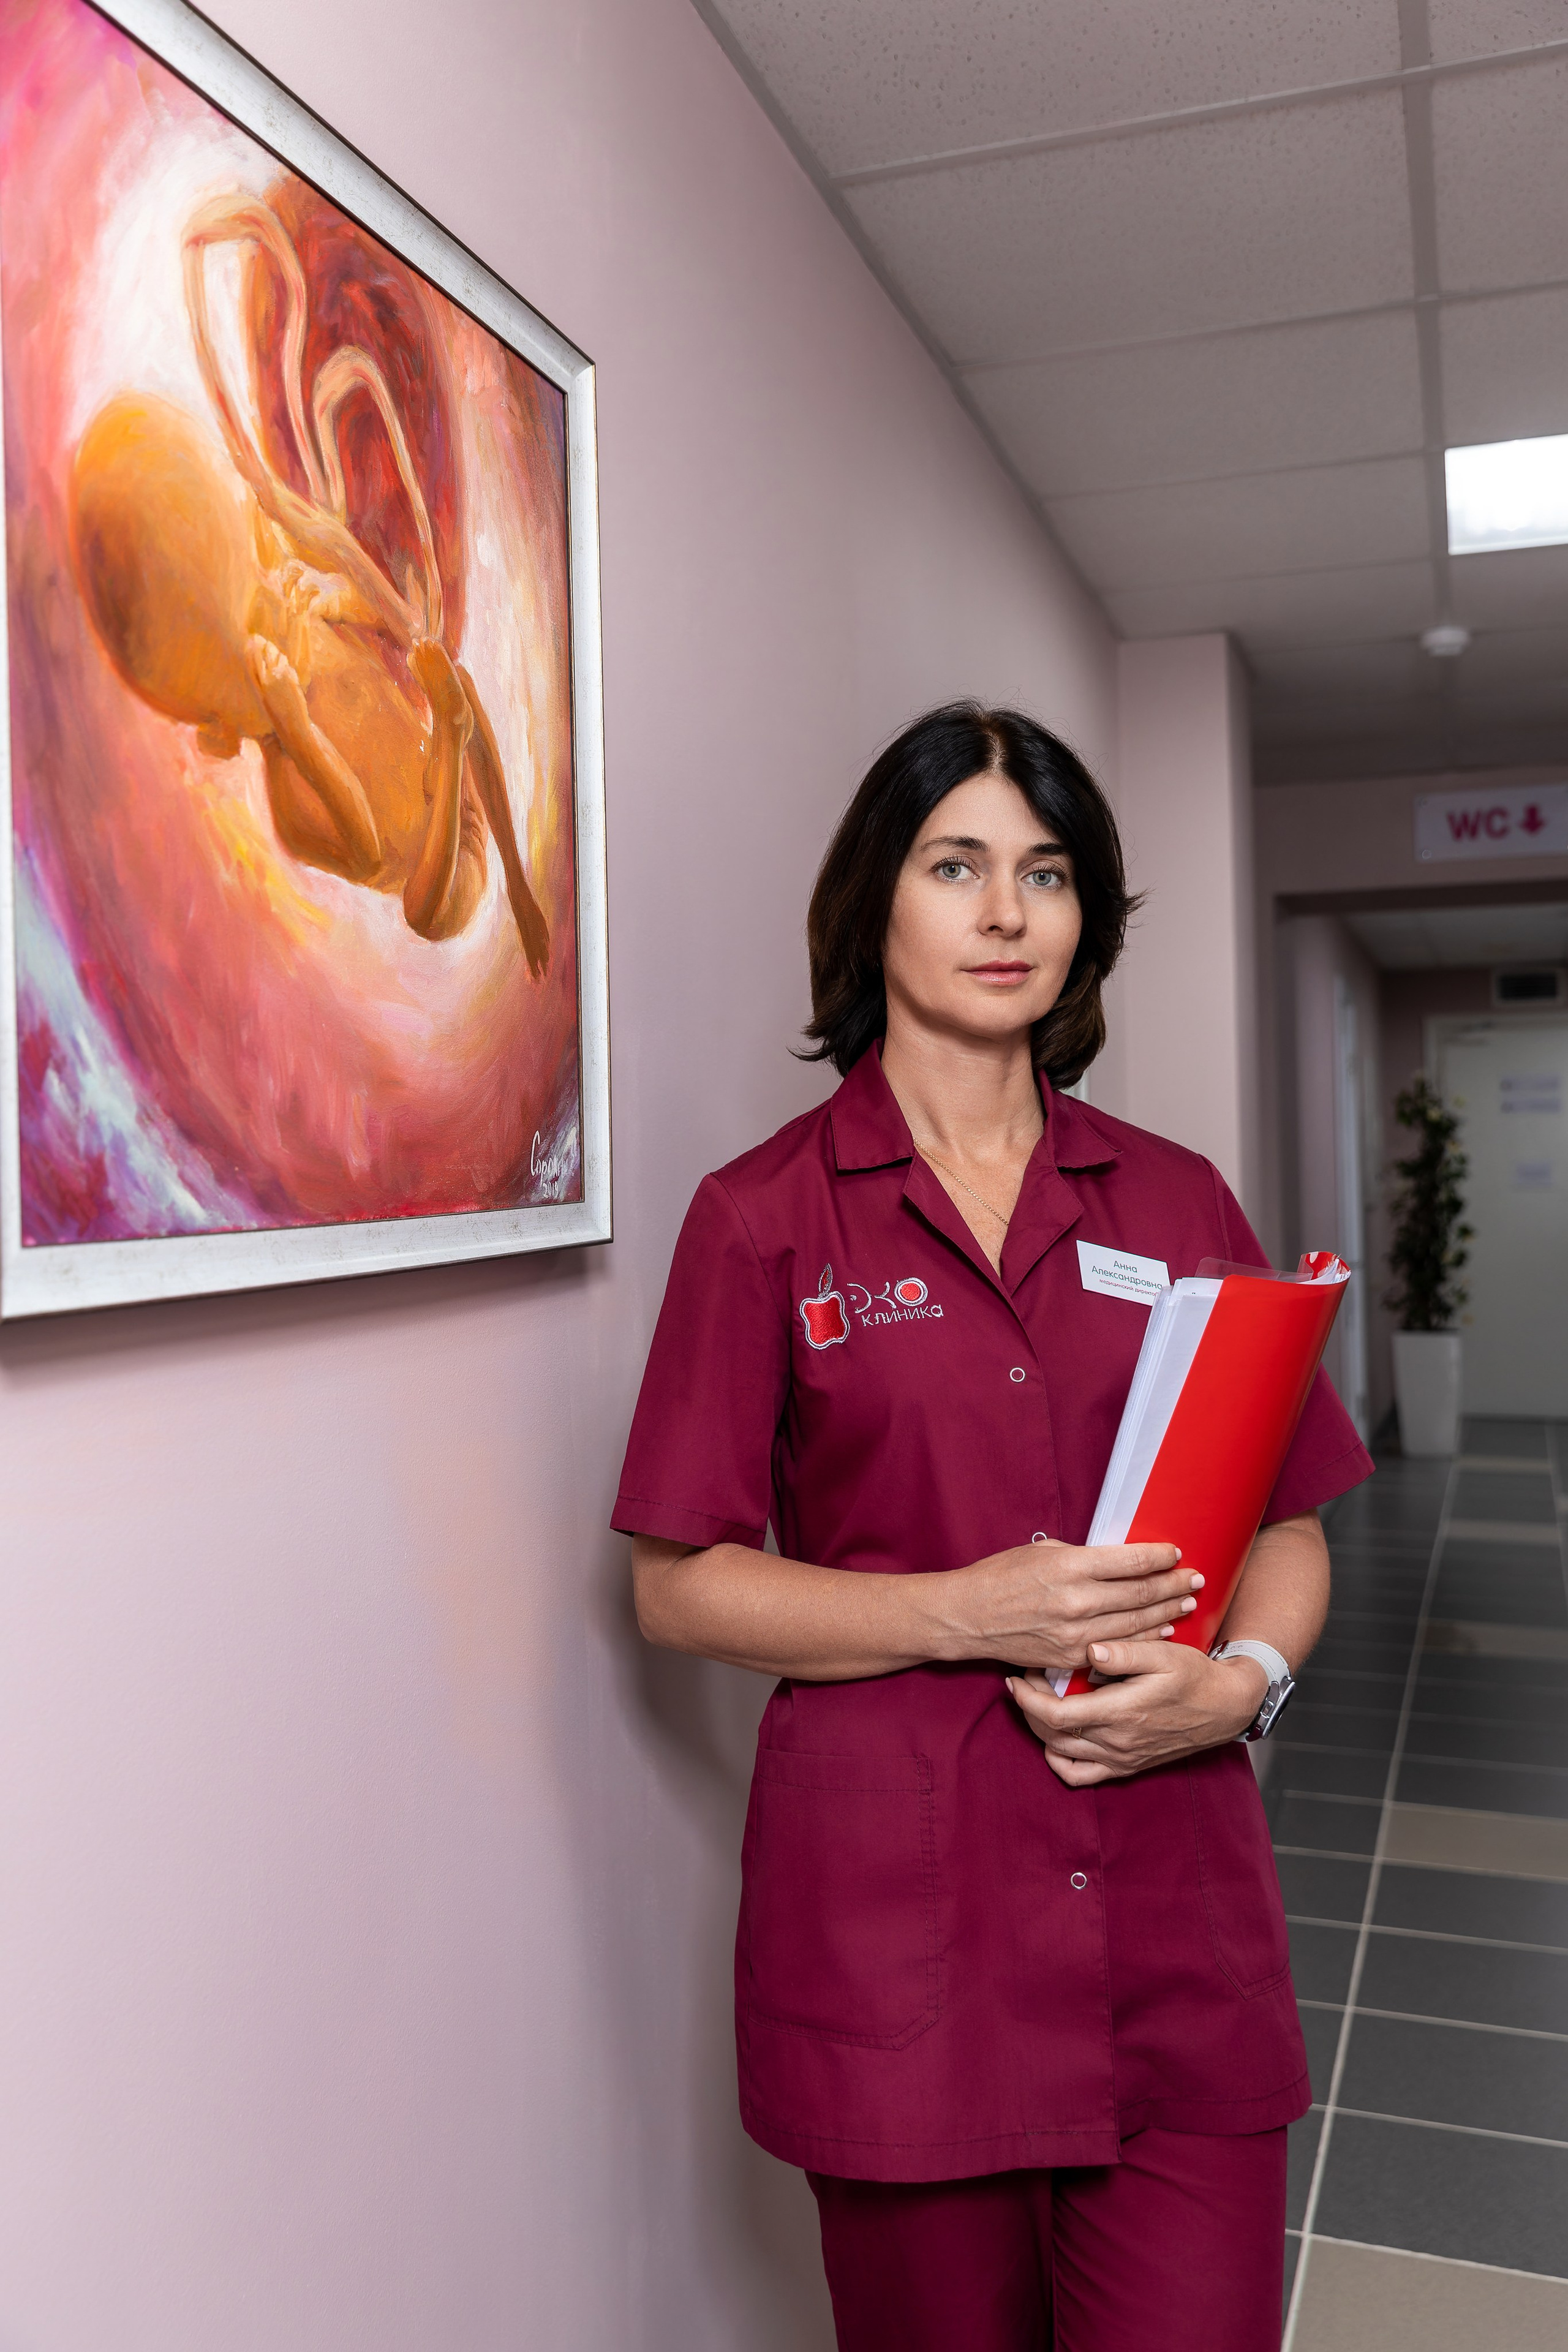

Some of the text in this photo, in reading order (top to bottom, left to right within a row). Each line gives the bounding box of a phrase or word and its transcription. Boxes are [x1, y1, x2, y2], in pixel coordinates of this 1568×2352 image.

[1446, 805, 1510, 843] WC
[1114, 1261, 1137, 1273] Анна
[1091, 1265, 1163, 1290] Александровна
[1099, 1279, 1134, 1291] медицинский
